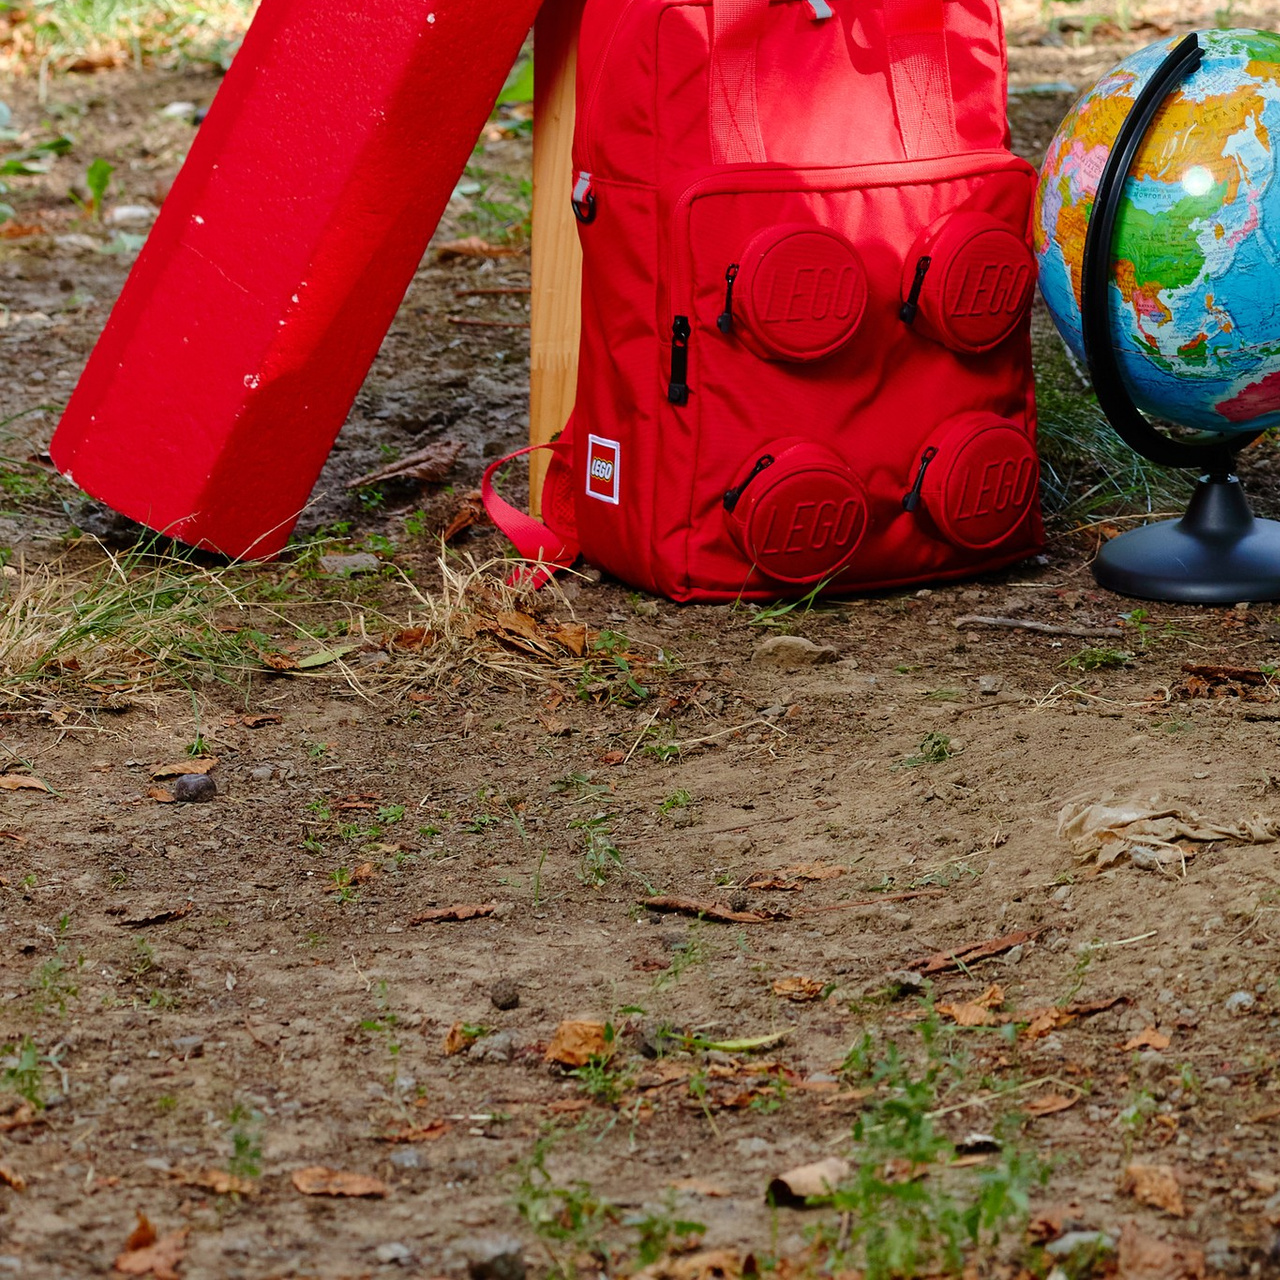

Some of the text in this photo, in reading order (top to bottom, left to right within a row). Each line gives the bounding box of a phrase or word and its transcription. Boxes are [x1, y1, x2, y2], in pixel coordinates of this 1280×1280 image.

[764, 264, 860, 324] LEGO
[951, 263, 1031, 318] LEGO
[591, 458, 613, 481] LEGO
[953, 456, 1034, 522] LEGO
[760, 497, 860, 557] LEGO
